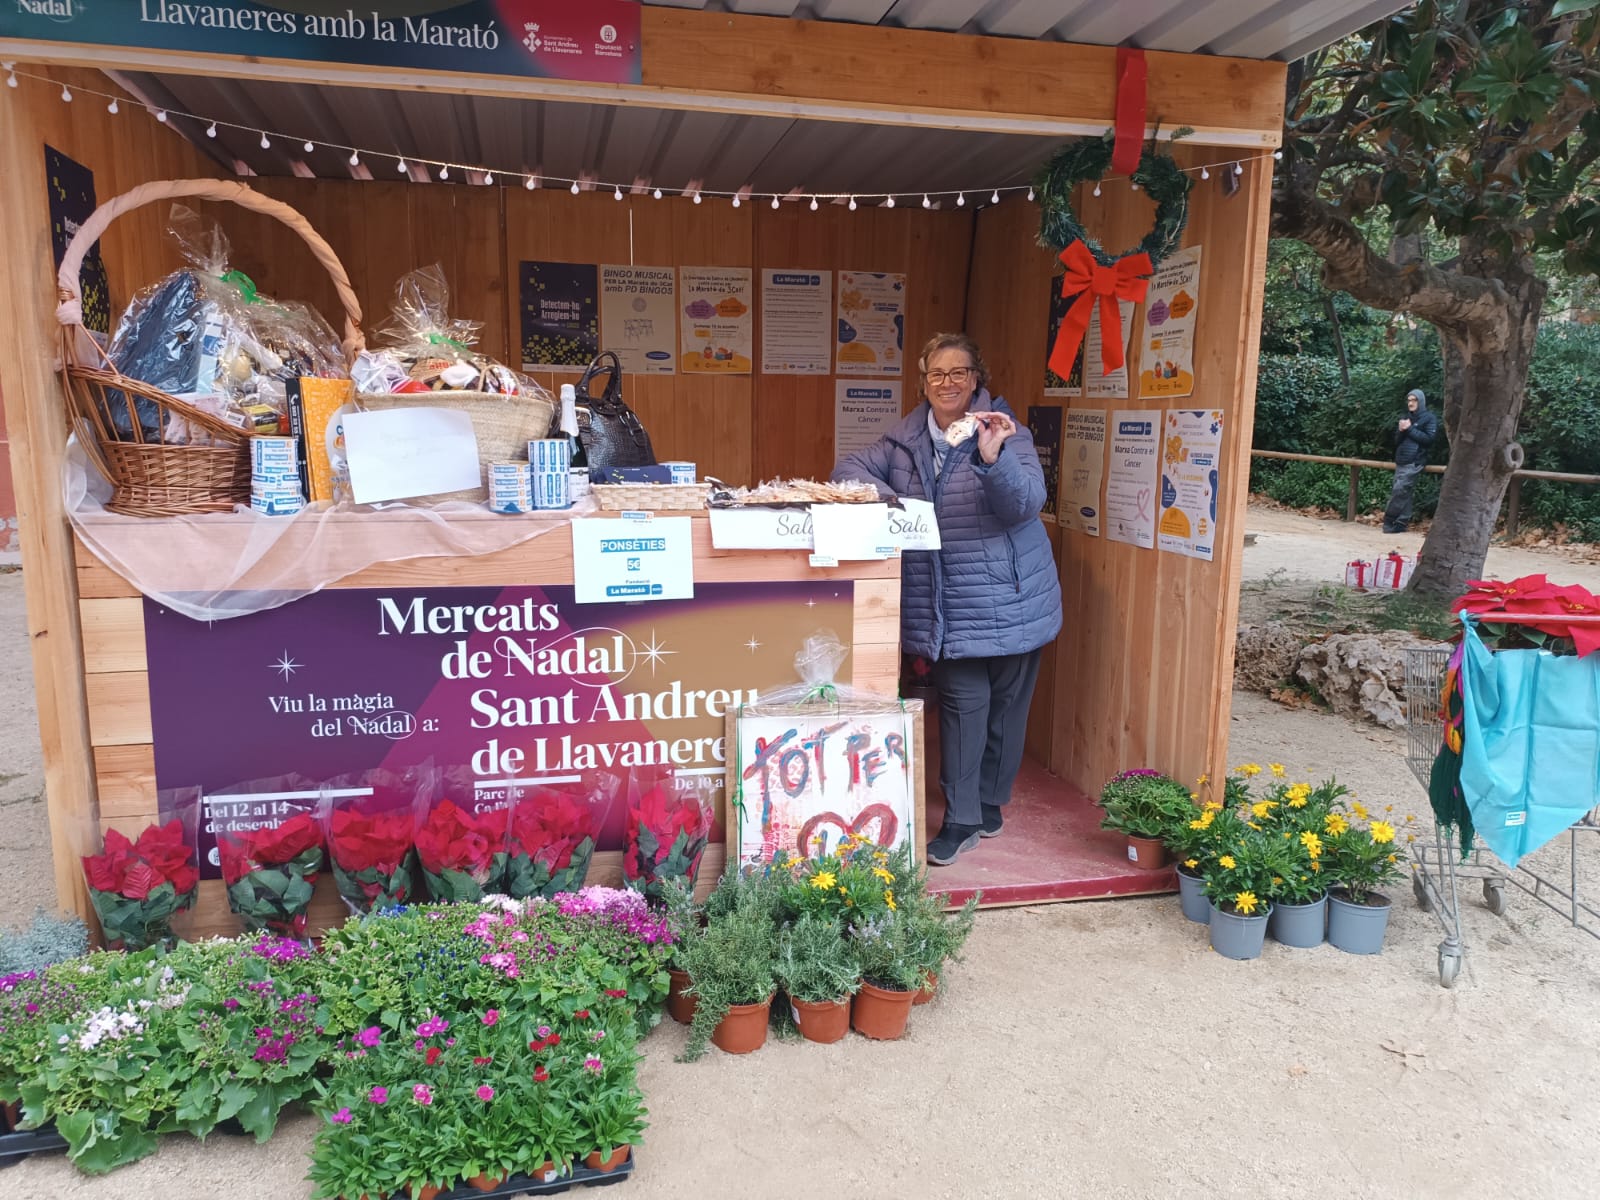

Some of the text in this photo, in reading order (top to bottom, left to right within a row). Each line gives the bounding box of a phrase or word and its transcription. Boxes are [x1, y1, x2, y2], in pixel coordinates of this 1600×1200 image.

[17, 0, 73, 16] Nadal
[141, 0, 499, 50] Llavaneres amb la Marató
[603, 269, 633, 278] BINGO
[634, 271, 674, 280] MUSICAL
[639, 286, 673, 295] BINGOS
[889, 514, 929, 535] Sala
[377, 597, 560, 636] Mercats
[441, 632, 631, 681] de Nadal
[268, 693, 395, 714] Viu la màgia
[470, 681, 757, 730] Sant Andreu
[311, 712, 440, 738] del Nadal a:
[472, 736, 726, 776] de Llavanere
[674, 777, 694, 791] De
[474, 789, 505, 801] Parc
[205, 800, 289, 819] Del 12 al 14
[205, 820, 223, 834] de
